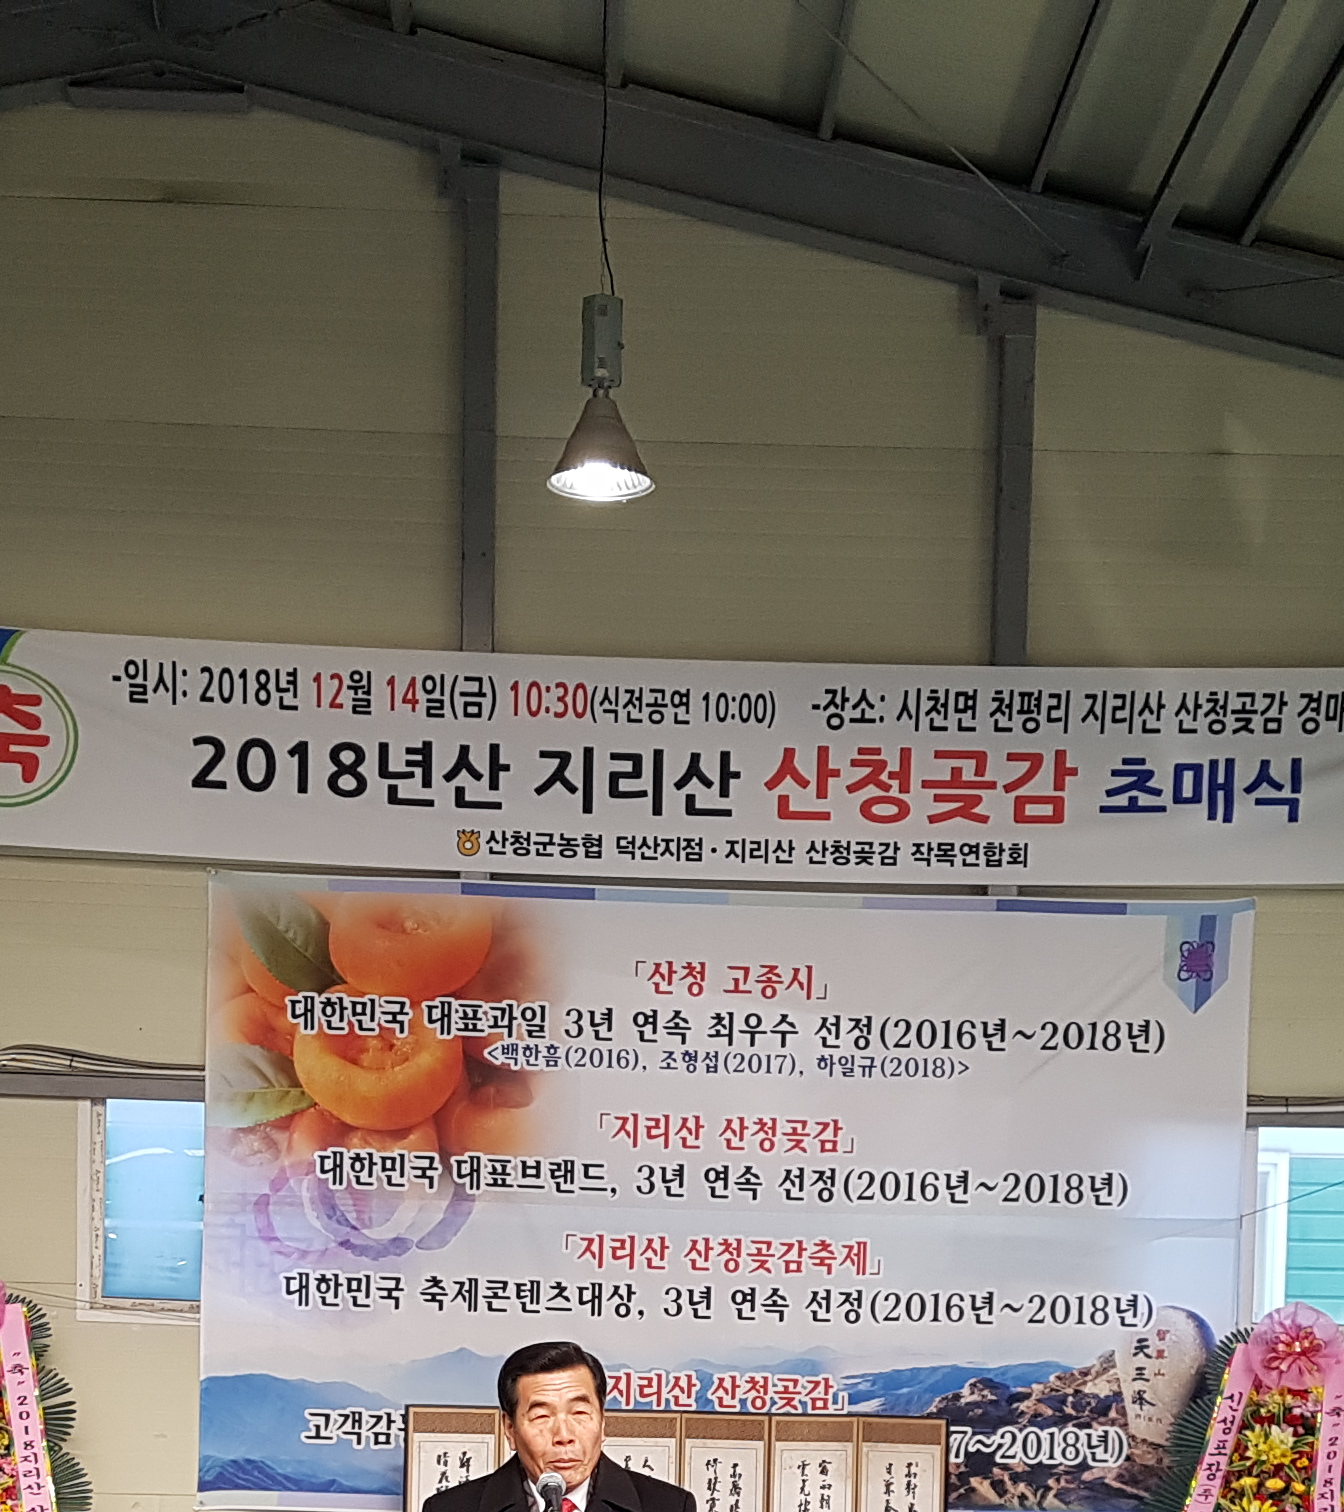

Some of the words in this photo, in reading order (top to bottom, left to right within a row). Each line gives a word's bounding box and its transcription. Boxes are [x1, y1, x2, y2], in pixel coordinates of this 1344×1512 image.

[111, 658, 188, 702] -일시:
[199, 665, 300, 711] 2018년
[311, 670, 373, 717] 12월
[385, 672, 496, 721] 14일(금)
[509, 679, 693, 728] 10:30(식전공연
[700, 690, 776, 728] 10:00)
[811, 686, 887, 732] -장소:
[896, 690, 978, 732] 시천면
[989, 689, 1070, 735] 천평리
[1081, 690, 1165, 736] 지리산
[1175, 690, 1289, 736] 산청곶감
[190, 735, 510, 810] 2018년산
[533, 746, 740, 817] 지리산
[764, 744, 1079, 826] 산청곶감
[1100, 756, 1304, 824] 초매식
[486, 831, 603, 862] 산청군농협
[616, 833, 704, 864] 덕산지점
[724, 839, 797, 866] 지리산
[804, 841, 901, 867] 산청곶감
[910, 841, 1029, 869] 작목연합회
[635, 960, 707, 997] 「산청
[723, 964, 828, 1001] 고종시」
[289, 995, 409, 1034] 대한민국
[425, 1001, 547, 1039] 대표과일
[564, 1008, 613, 1041] 3년
[632, 1010, 692, 1044] 연속
[708, 1010, 798, 1048] 최우수
[815, 1017, 1165, 1055] 선정(2016년~2018년)
[659, 1050, 803, 1078] 조형섭(2017),
[817, 1055, 969, 1079] 하일규(2018)>
[599, 1113, 703, 1150] 「지리산
[719, 1115, 854, 1154] 산청곶감」
[316, 1150, 438, 1189] 대한민국
[457, 1157, 617, 1197] 대표브랜드,
[636, 1164, 685, 1195] 3년
[704, 1165, 762, 1200] 연속
[779, 1168, 1128, 1206] 선정(2016년~2018년)
[564, 1233, 669, 1270] 「지리산
[684, 1237, 883, 1277] 산청곶감축제」
[283, 1272, 404, 1309] 대한민국
[419, 1275, 645, 1319] 축제콘텐츠대상,
[663, 1286, 713, 1317] 3년
[731, 1287, 789, 1323] 연속
[806, 1289, 1155, 1329] 선정(2016년~2018년)
[606, 1371, 697, 1411] 지리산
[304, 1408, 405, 1448] 고객감
